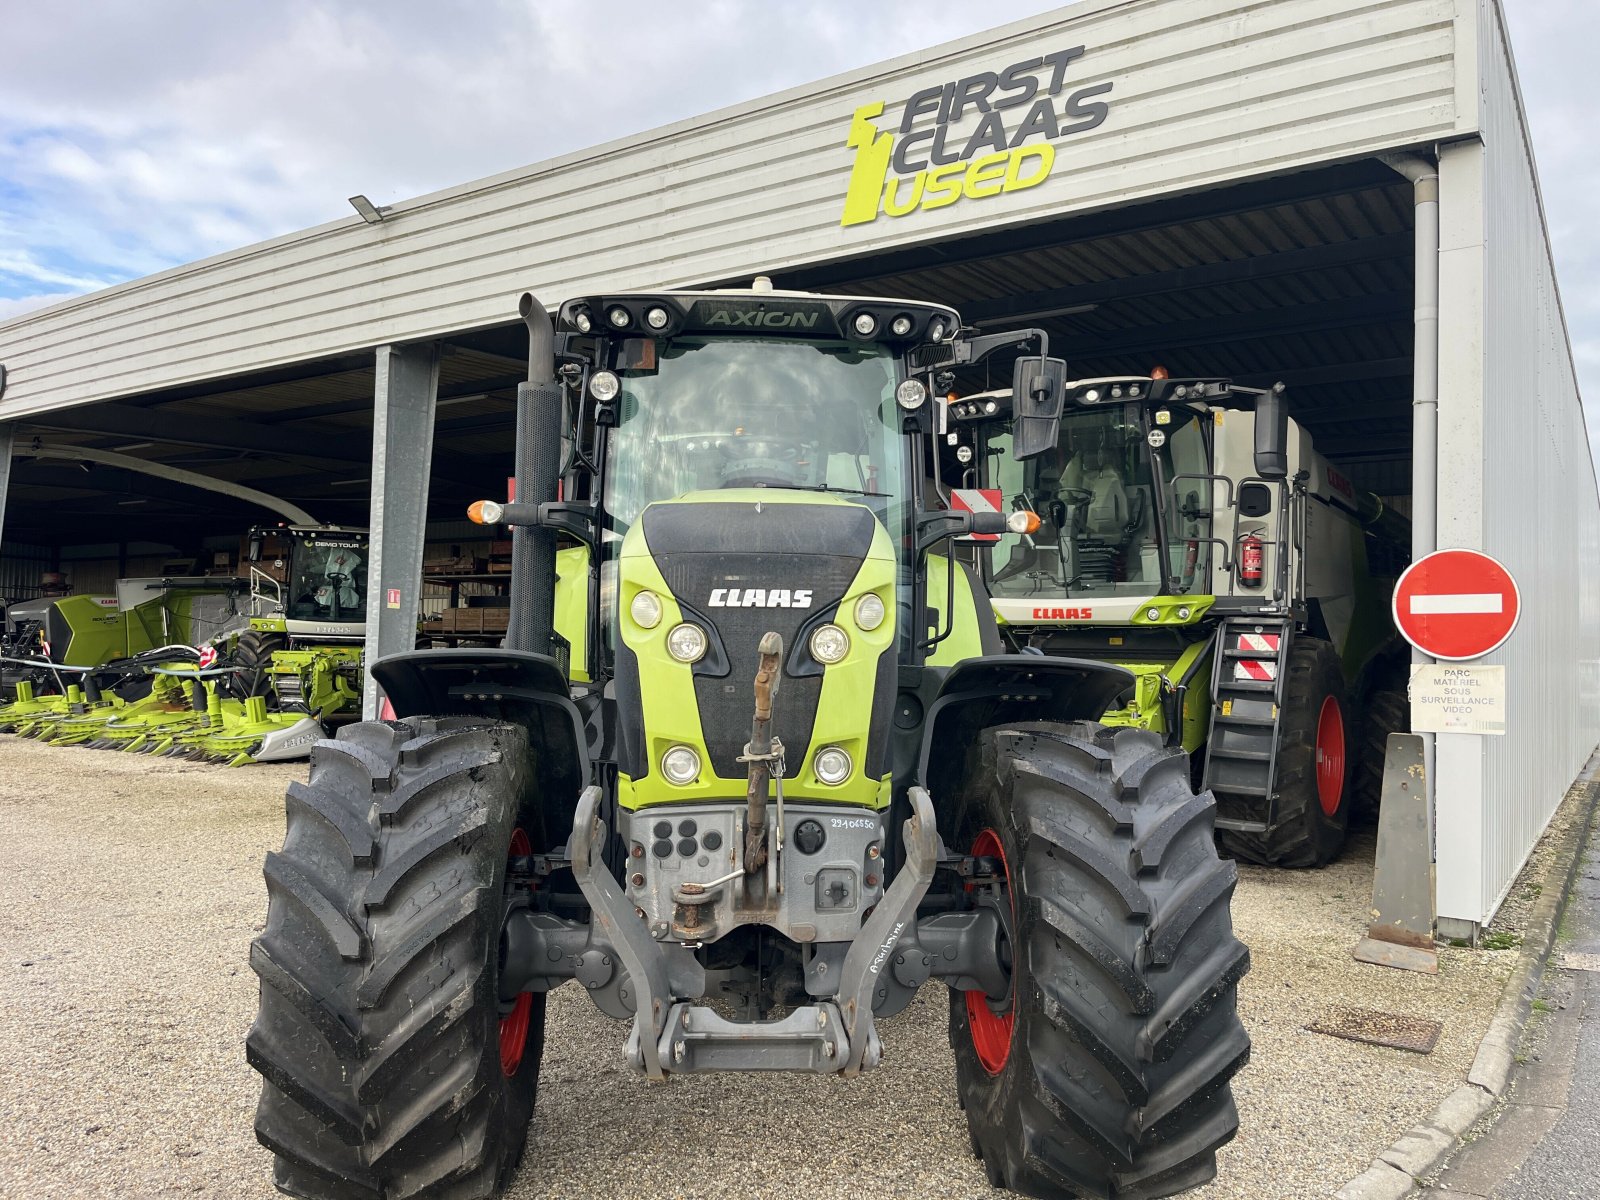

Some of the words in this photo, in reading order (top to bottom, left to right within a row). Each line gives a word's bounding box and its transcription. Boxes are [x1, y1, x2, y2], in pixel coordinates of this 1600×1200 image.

[900, 44, 1085, 133] FIRST
[893, 82, 1113, 174] CLAAS
[883, 143, 1055, 217] USED
[708, 588, 813, 609] CLAAS
[1033, 607, 1092, 620] CLAAS
[1444, 669, 1471, 677] PARC
[1444, 687, 1471, 696] SOUS
[1421, 696, 1495, 705] SURVEILLANCE
